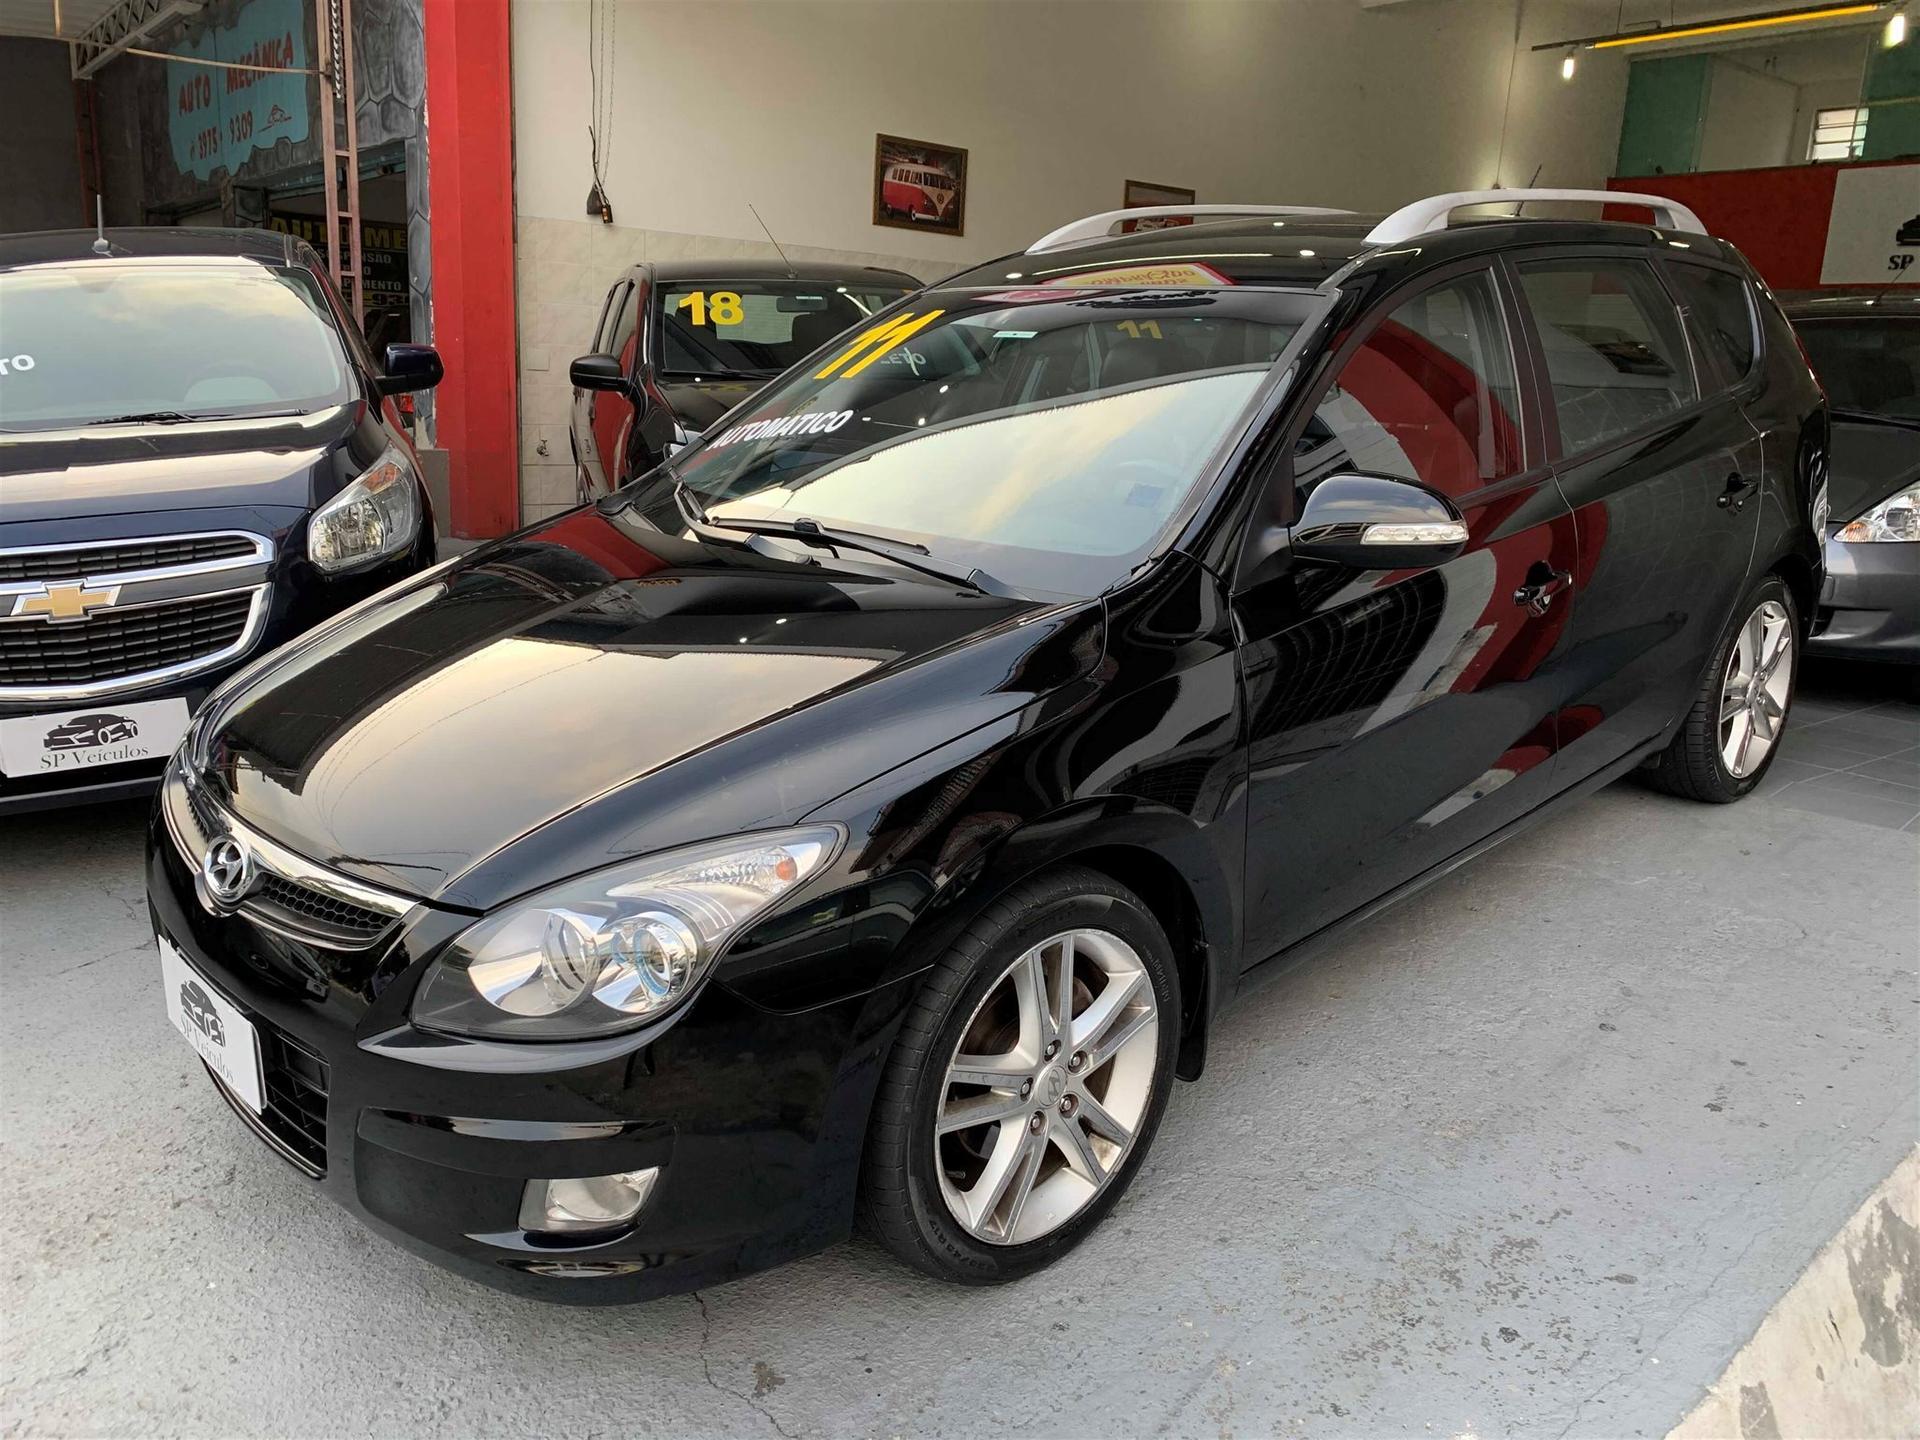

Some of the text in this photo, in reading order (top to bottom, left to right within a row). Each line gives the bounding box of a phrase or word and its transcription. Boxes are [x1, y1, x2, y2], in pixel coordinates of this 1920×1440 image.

[179, 73, 211, 116] AUTO
[229, 110, 253, 145] 9309
[1887, 254, 1915, 271] SP
[679, 291, 744, 326] 18
[812, 309, 946, 379] 11
[704, 410, 854, 451] AUTOMATICO
[40, 754, 66, 769] SP
